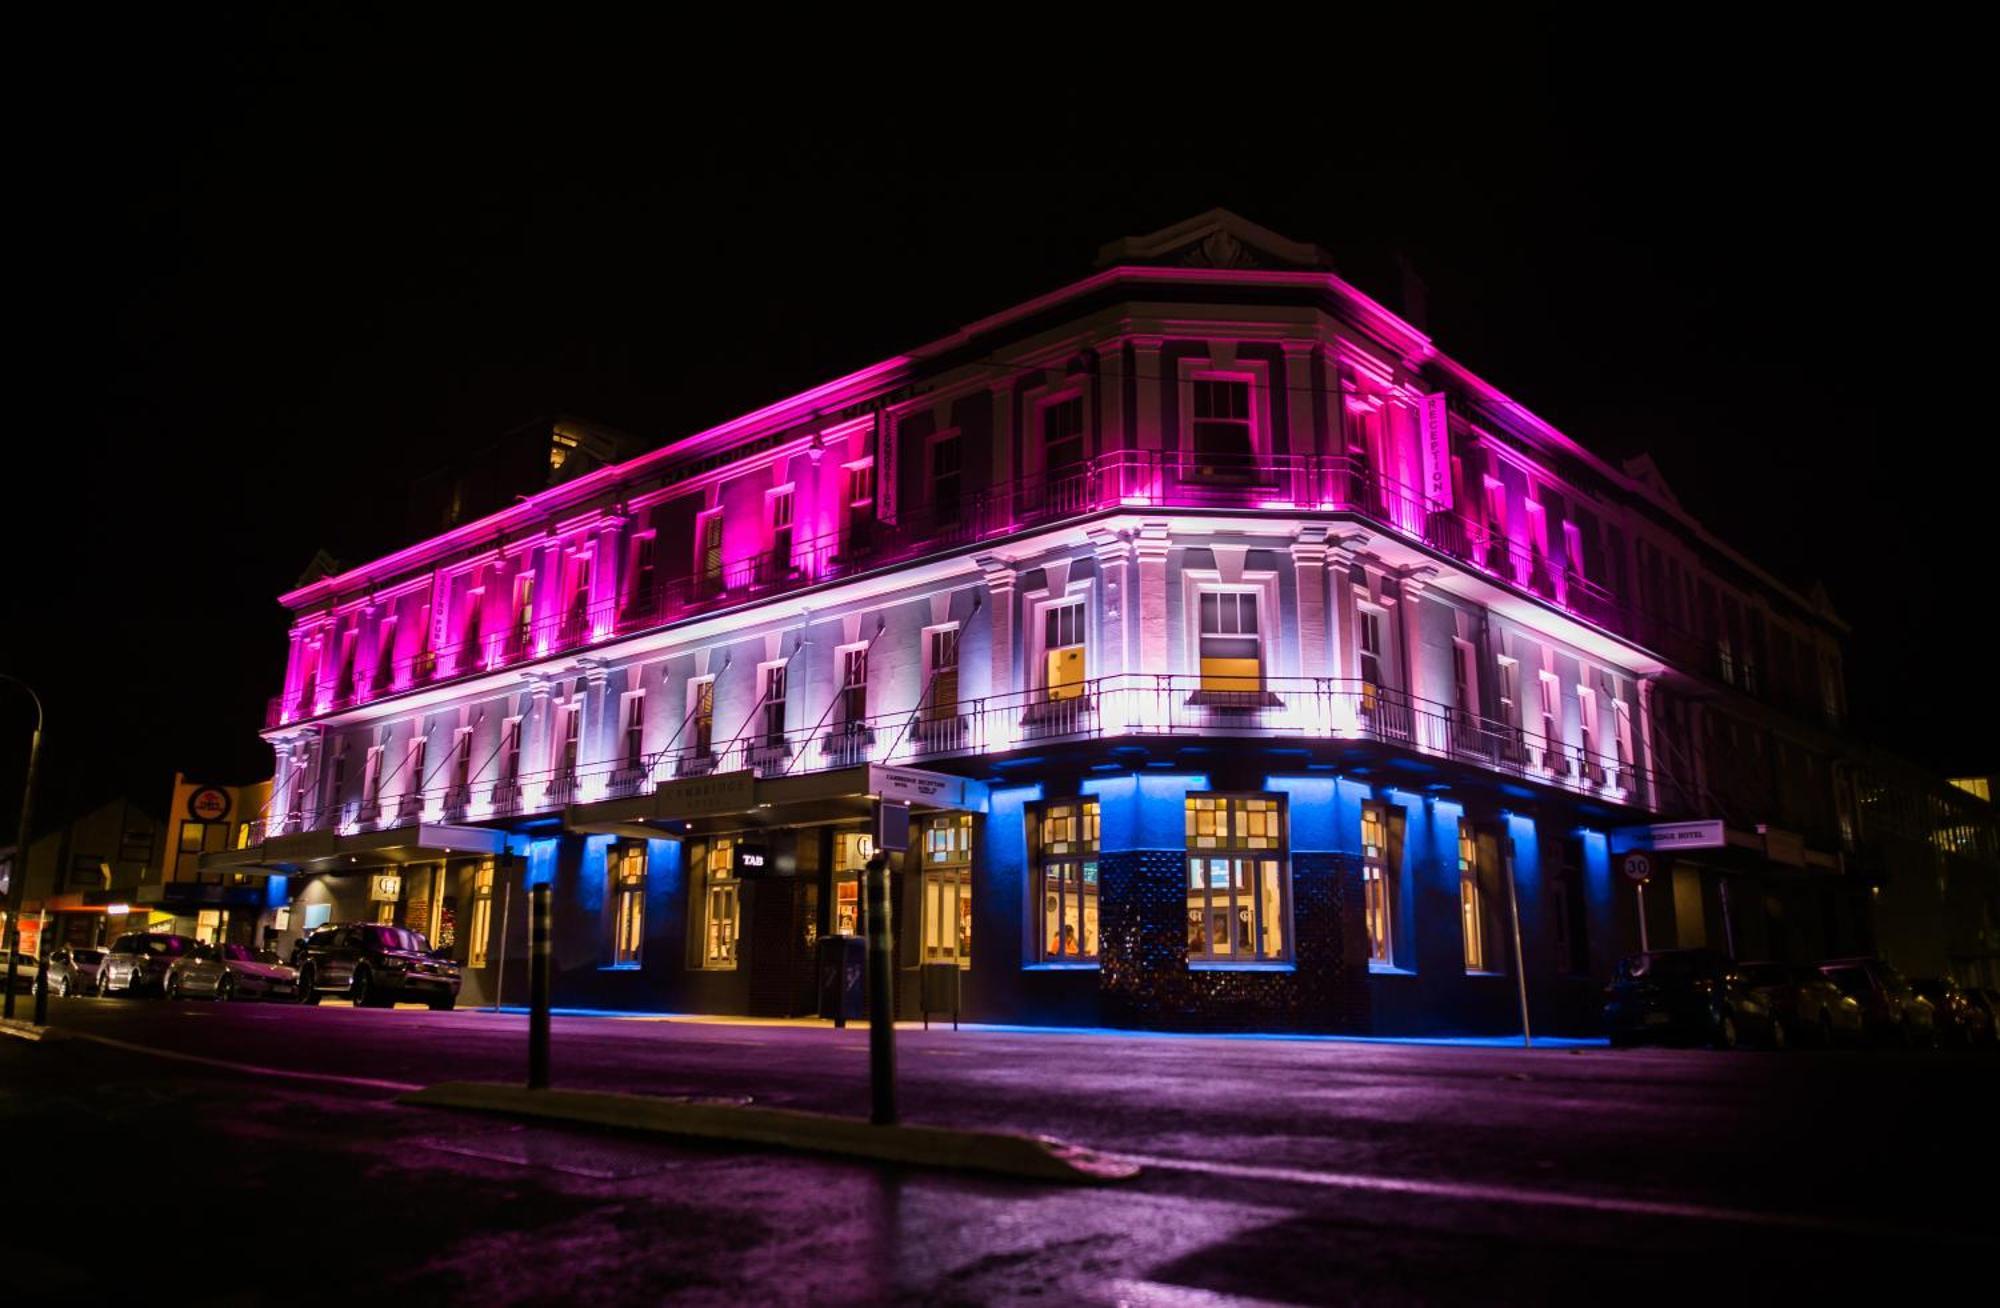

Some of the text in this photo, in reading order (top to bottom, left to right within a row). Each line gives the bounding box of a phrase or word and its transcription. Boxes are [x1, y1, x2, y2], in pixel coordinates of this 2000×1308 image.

[1427, 399, 1443, 492] RECEPTION
[742, 854, 764, 866] TAB
[1627, 860, 1648, 874] 30
